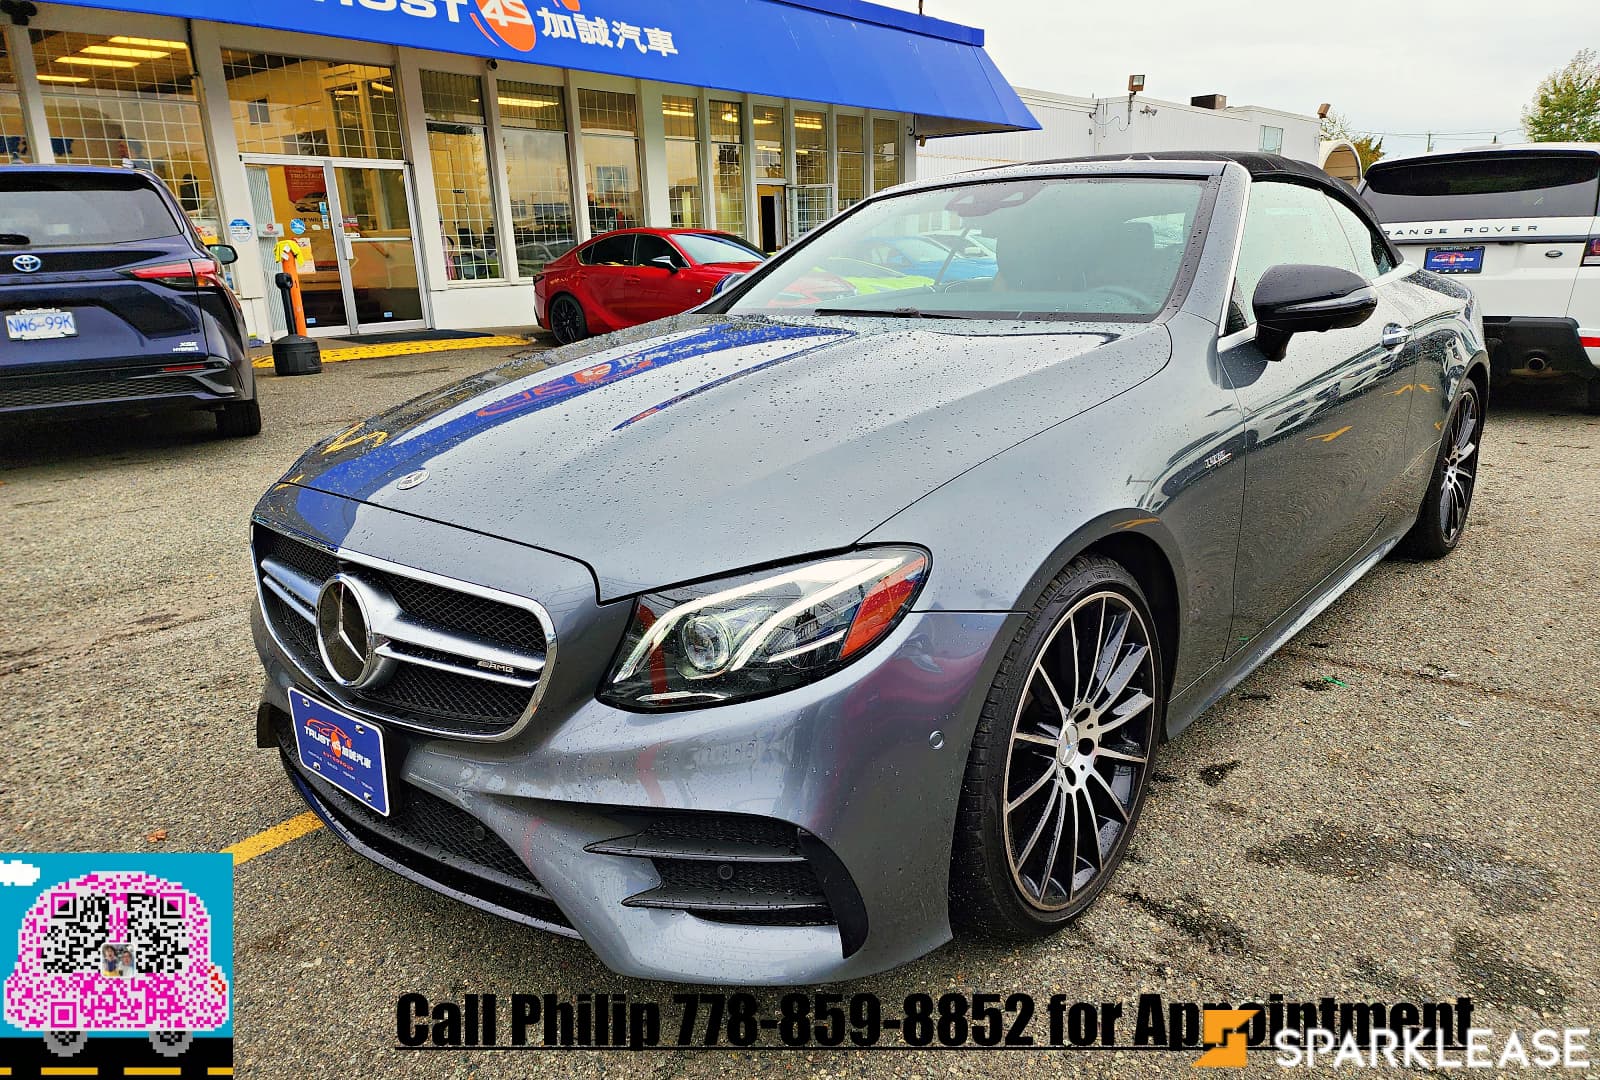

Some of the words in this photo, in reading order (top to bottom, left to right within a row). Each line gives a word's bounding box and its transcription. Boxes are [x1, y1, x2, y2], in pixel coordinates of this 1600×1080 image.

[536, 6, 679, 57] 加誠汽車
[1463, 225, 1538, 234] ROVER
[304, 725, 331, 747] TRUST
